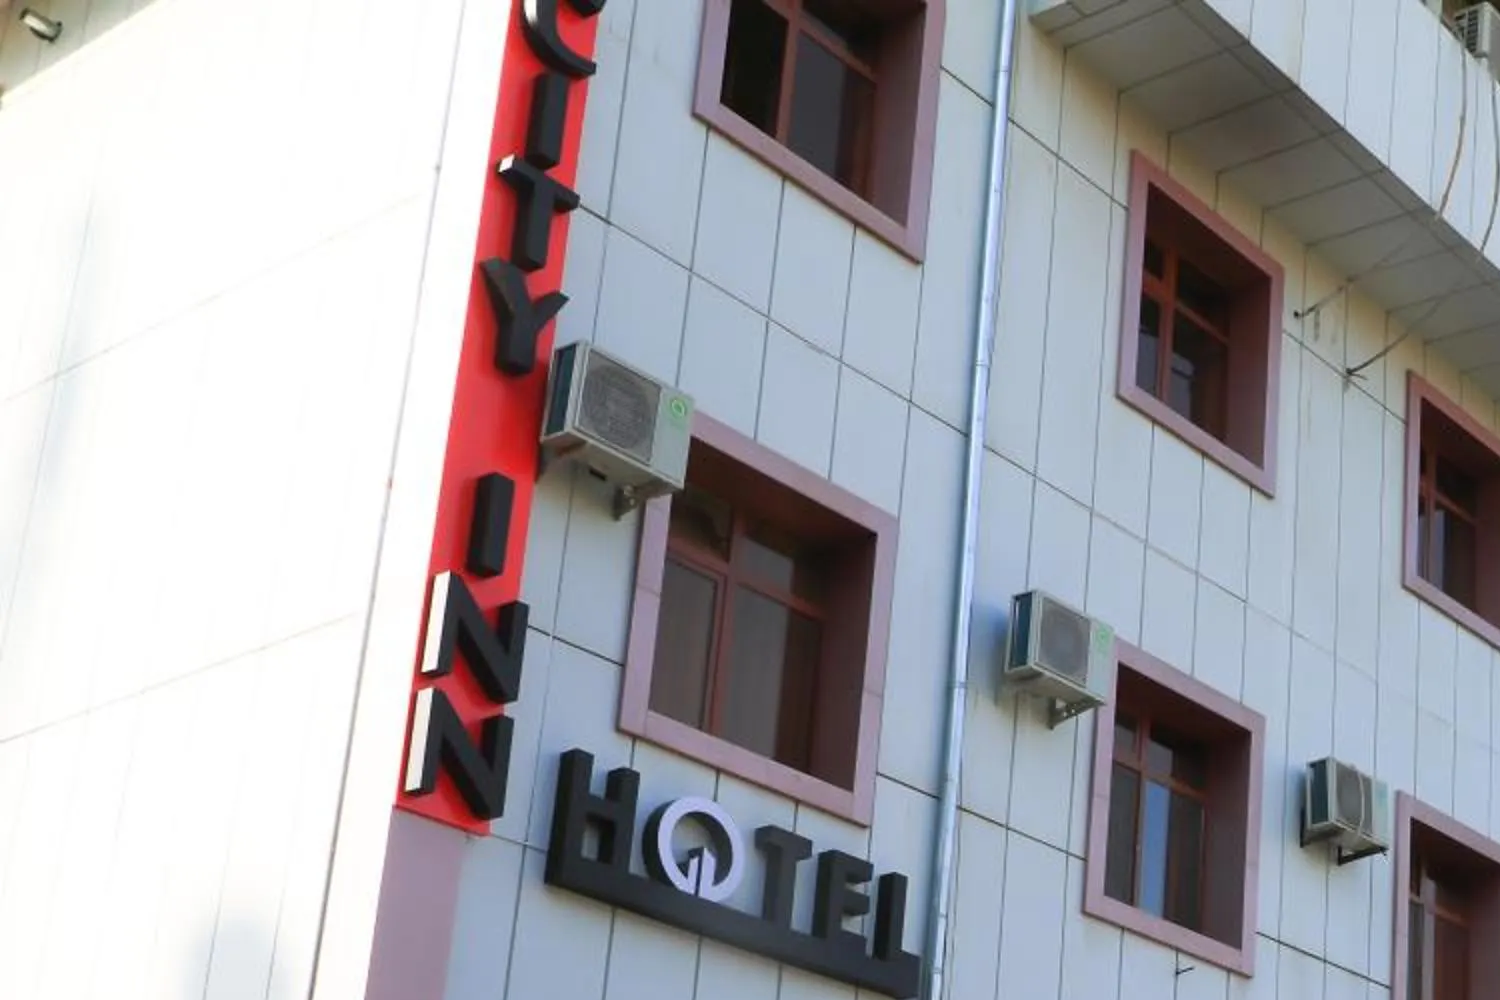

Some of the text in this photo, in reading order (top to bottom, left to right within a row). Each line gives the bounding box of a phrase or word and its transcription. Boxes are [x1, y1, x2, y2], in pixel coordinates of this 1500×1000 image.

[404, 0, 606, 821] CITY INN
[545, 747, 919, 1000] HOTEL
